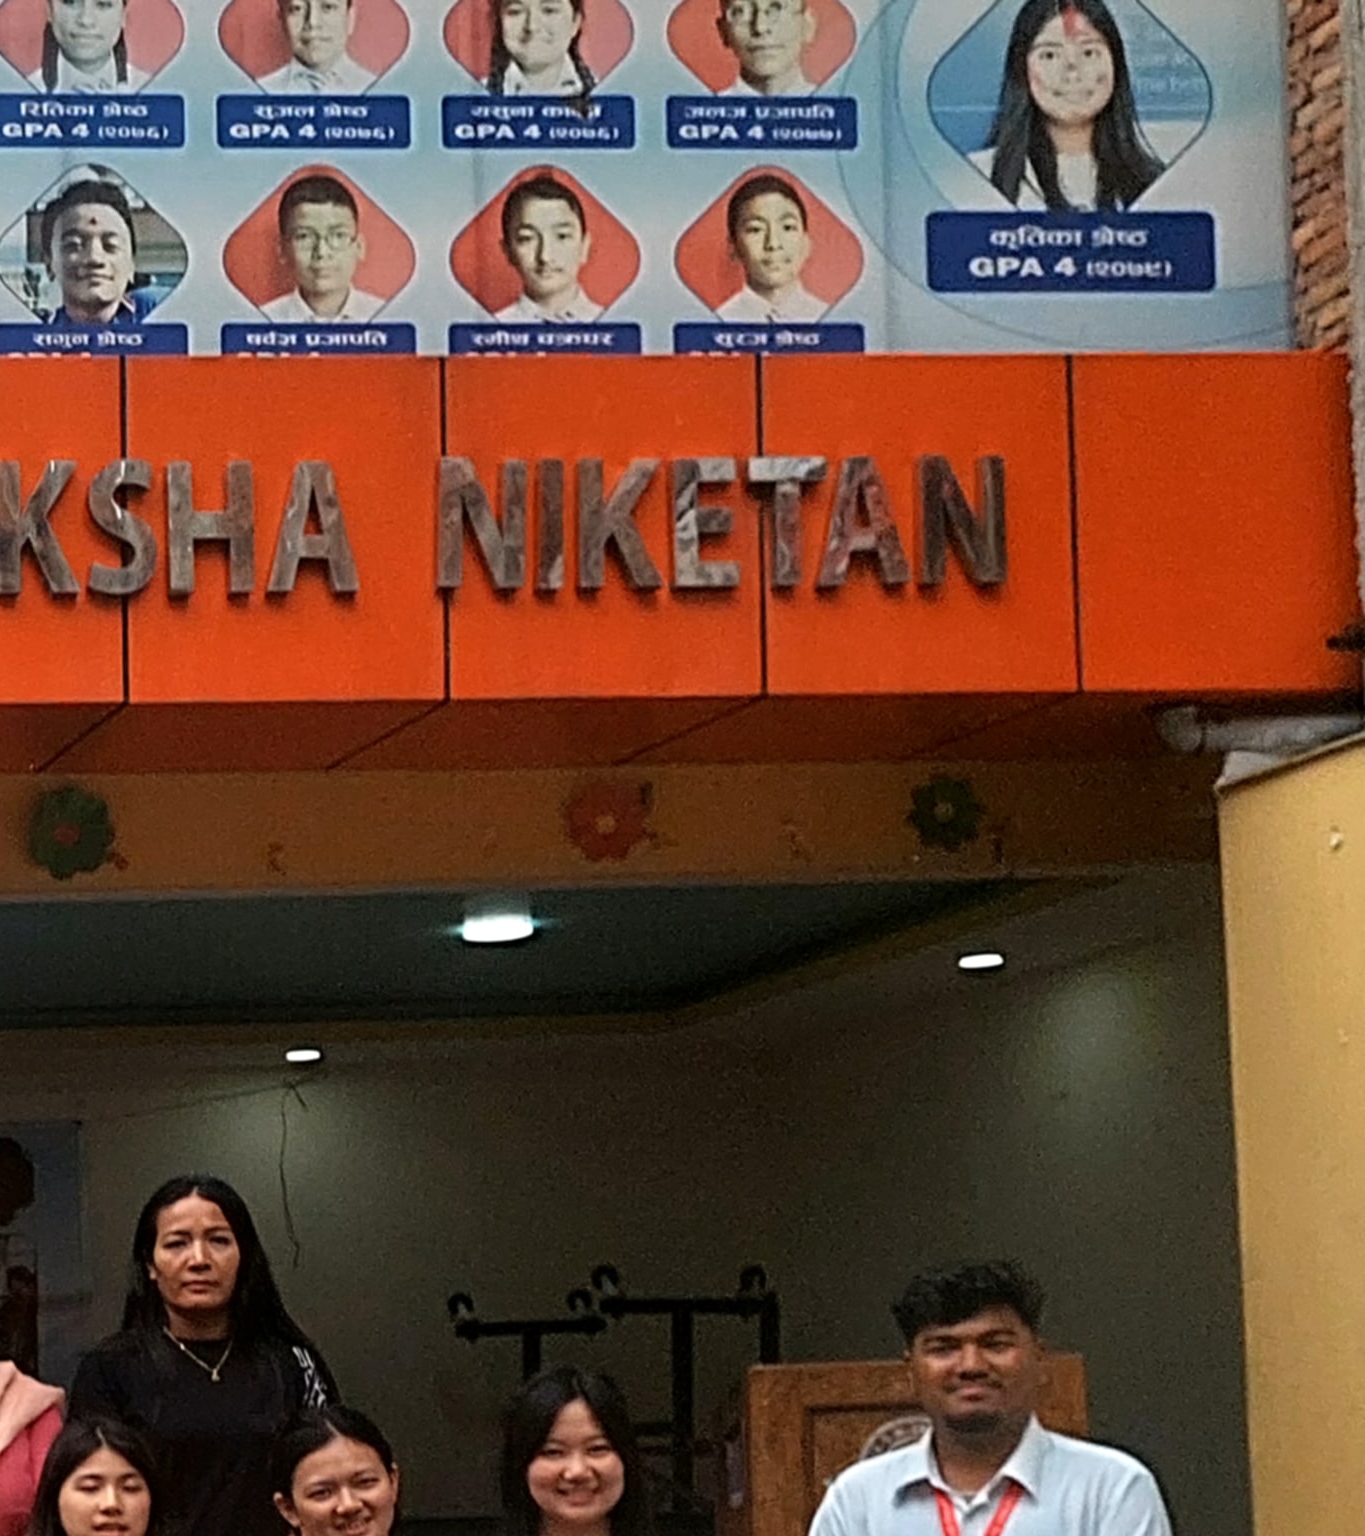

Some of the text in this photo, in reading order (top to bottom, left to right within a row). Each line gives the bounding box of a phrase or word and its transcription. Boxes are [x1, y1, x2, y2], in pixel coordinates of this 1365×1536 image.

[2, 123, 64, 138] GPA
[71, 123, 90, 138] 4
[229, 124, 290, 139] GPA
[298, 124, 317, 139] 4
[455, 124, 515, 140] GPA
[524, 124, 542, 140] 4
[679, 124, 738, 140] GPA
[747, 124, 765, 140] 4
[968, 257, 1044, 277] GPA
[1054, 257, 1077, 277] 4
[434, 453, 1009, 596] NIKETAN
